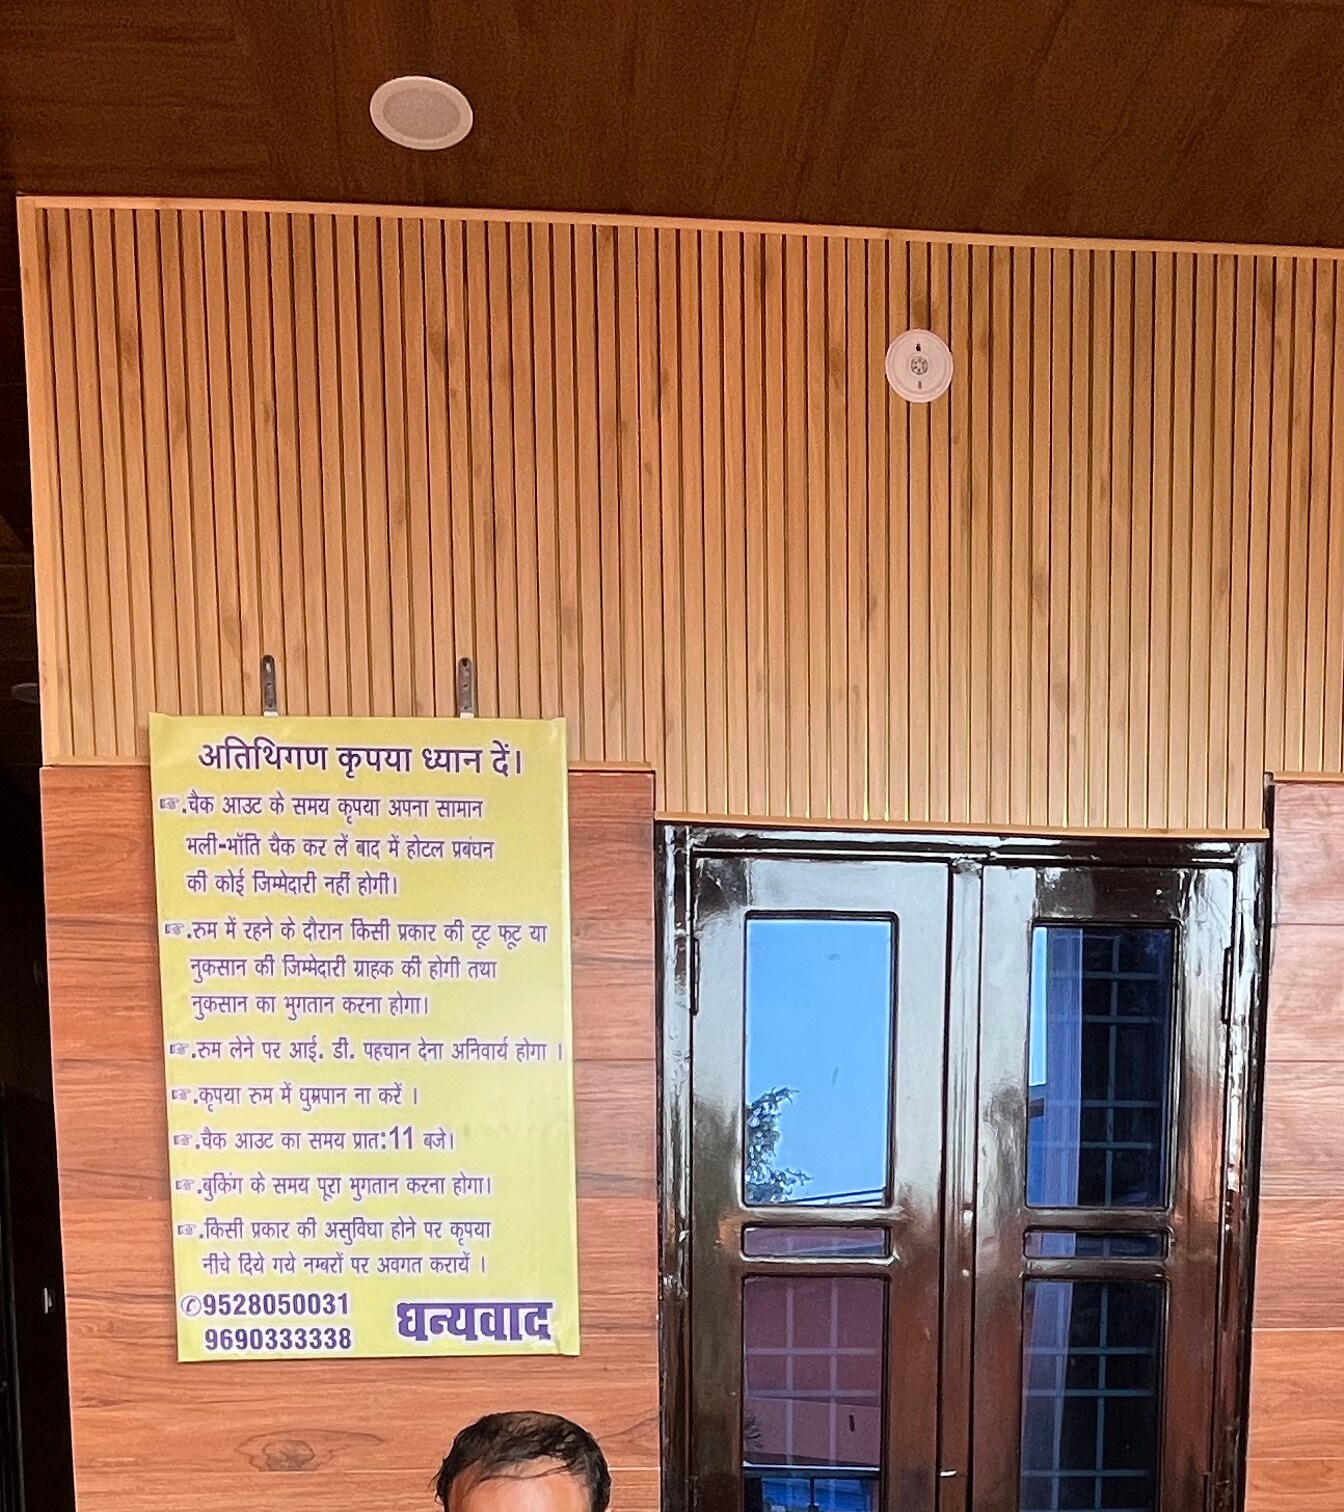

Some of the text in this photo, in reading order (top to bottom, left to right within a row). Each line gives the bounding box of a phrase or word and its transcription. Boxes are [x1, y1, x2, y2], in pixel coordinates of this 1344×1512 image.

[198, 736, 328, 770] अतिथिगण
[336, 748, 412, 778] कृपया
[422, 748, 483, 773] ध्यान
[222, 797, 262, 814] आउट
[269, 791, 284, 815] के
[292, 798, 330, 815] समय
[337, 799, 380, 824] कृपया
[389, 800, 429, 817] अपना
[435, 800, 483, 818] सामान
[268, 831, 295, 856] चैक
[302, 839, 327, 856] कर
[333, 833, 348, 857] लें
[355, 840, 380, 859] बाद
[387, 834, 400, 857] में
[405, 834, 445, 860] होटल
[186, 870, 208, 892] की
[215, 868, 244, 897] कोई
[252, 869, 317, 895] जिम्मेदारी
[323, 871, 350, 896] नहीं
[224, 916, 237, 939] में
[243, 916, 273, 941] रहने
[280, 916, 295, 939] के
[302, 916, 343, 942] दौरान
[350, 918, 390, 941] किसी
[397, 924, 437, 941] प्रकार
[443, 919, 464, 941] की
[471, 925, 491, 949] टूट
[497, 925, 521, 950] फूट
[529, 926, 547, 942] या
[190, 953, 497, 983] नुकसान की जिम्मेदारी ग्राहक की होगी तथा
[191, 991, 427, 1021] नुकसान का भुगतान करना होगा।
[229, 1036, 255, 1058] लेने
[262, 1042, 281, 1058] पर
[290, 1035, 323, 1062] आई.
[332, 1037, 354, 1059] डी.
[363, 1043, 411, 1061] पहचान
[417, 1037, 444, 1061] देना
[452, 1036, 509, 1060] अनिवार्य
[248, 1088, 274, 1104] रुम
[280, 1082, 292, 1104] में
[353, 1088, 371, 1104] ना
[378, 1082, 402, 1105] करें
[235, 1133, 273, 1149] आउट
[280, 1133, 301, 1149] का
[308, 1133, 346, 1149] समय
[250, 1171, 265, 1194] के
[272, 1178, 310, 1194] समय
[317, 1178, 341, 1201] पूरा
[350, 1177, 399, 1201] भुगतान
[406, 1178, 446, 1194] करना
[452, 1172, 490, 1196] होगा।
[251, 1222, 290, 1238] प्रकार
[296, 1217, 317, 1238] की
[325, 1217, 384, 1245] असुविधा
[390, 1216, 417, 1240] होने
[423, 1222, 442, 1238] पर
[449, 1222, 491, 1246] कृपया
[202, 1252, 231, 1274] नीचे
[238, 1251, 265, 1276] दिये
[272, 1251, 296, 1273] गये
[303, 1251, 344, 1273] नम्बरों
[350, 1258, 370, 1273] पर
[377, 1257, 423, 1273] अवगत
[203, 1293, 347, 1315] 9528050031
[397, 1302, 553, 1341] धन्यवाद
[205, 1328, 351, 1350] 9690333338
